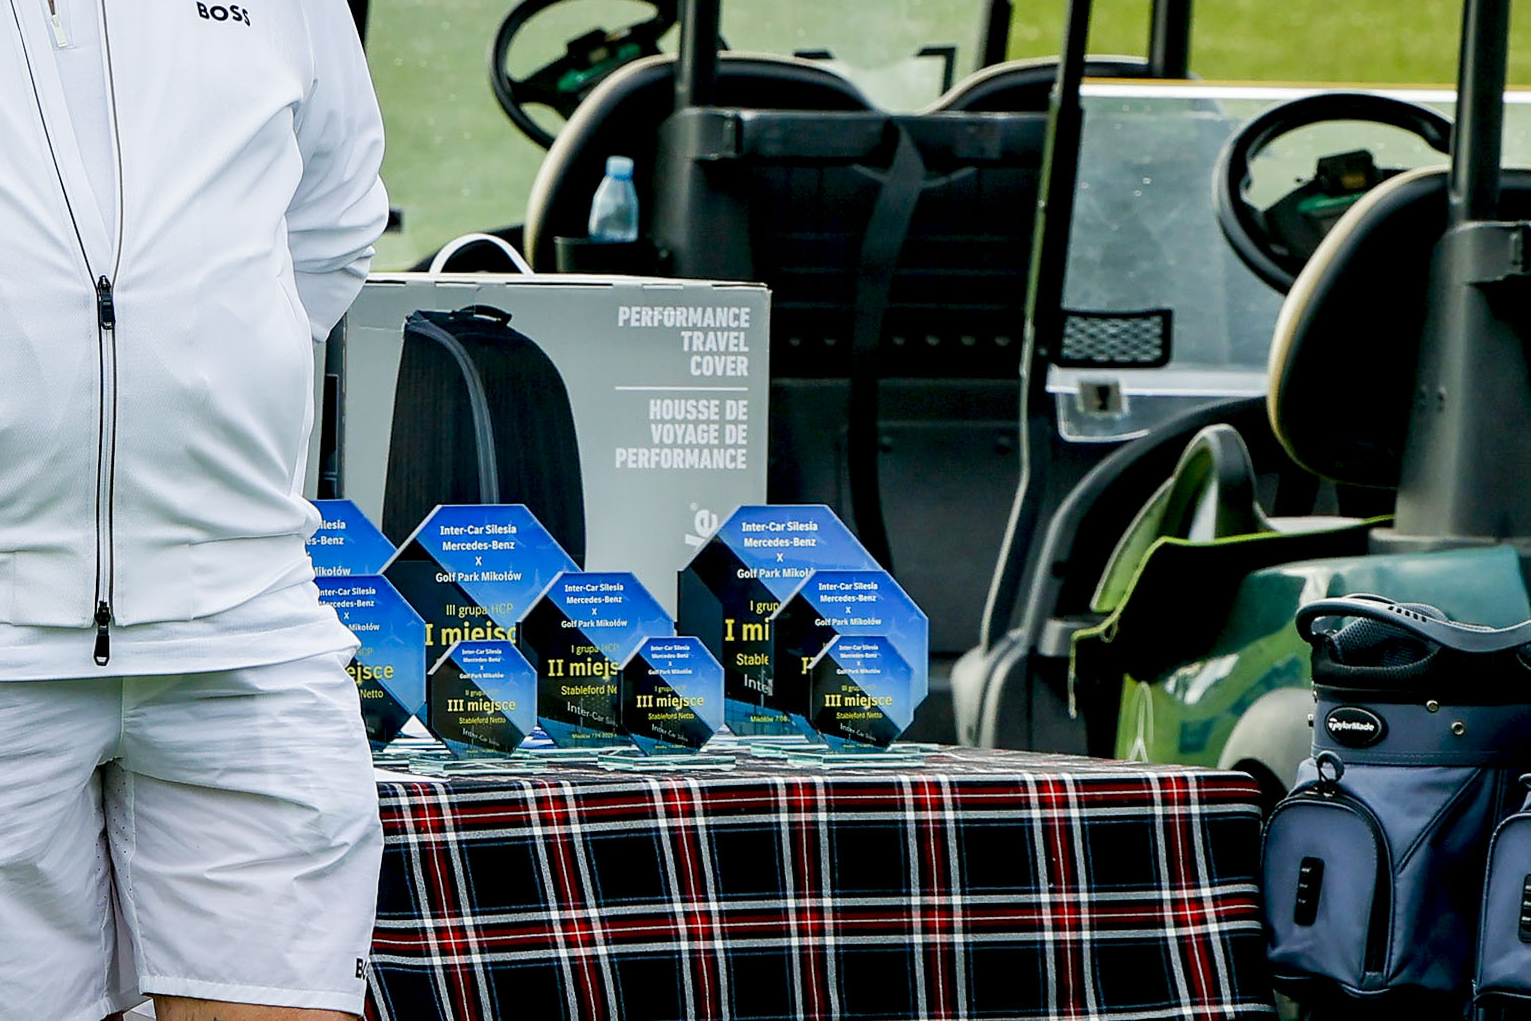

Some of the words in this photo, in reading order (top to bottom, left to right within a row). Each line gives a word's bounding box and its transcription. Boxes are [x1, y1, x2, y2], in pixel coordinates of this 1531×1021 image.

[196, 1, 250, 27] BOSS
[618, 306, 750, 327] PERFORMANCE
[681, 331, 749, 352] TRAVEL
[690, 355, 748, 376] COVER
[650, 399, 720, 420] HOUSSE
[725, 399, 748, 420] DE
[651, 424, 719, 445] VOYAGE
[725, 424, 748, 445] DE
[615, 448, 747, 469] PERFORMANCE
[440, 525, 484, 535] Inter-Car
[485, 524, 517, 534] Silesia
[741, 522, 786, 532] Inter-Car
[787, 521, 818, 532] Silesia
[306, 536, 345, 545] es-Benz
[442, 540, 516, 551] Mercedes-Benz
[743, 537, 817, 547] Mercedes-Benz
[435, 572, 456, 583] Golf
[458, 571, 479, 582] Park
[481, 570, 522, 581] Mikołów
[737, 568, 757, 579] Golf
[759, 568, 781, 578] Park
[351, 586, 376, 595] Silesia
[564, 584, 599, 592] Inter-Car
[599, 583, 624, 591] Silesia
[818, 583, 853, 591] Inter-Car
[853, 581, 878, 590] Silesia
[566, 595, 623, 604] Mercedes-Benz
[819, 594, 877, 602] Mercedes-Benz
[446, 604, 456, 616] III
[458, 605, 487, 619] grupa
[756, 602, 780, 614] grup
[561, 620, 577, 628] Golf
[578, 619, 595, 627] Park
[814, 618, 831, 627] Golf
[831, 617, 848, 626] Park
[724, 618, 735, 642] I
[576, 646, 599, 655] grupa
[736, 653, 769, 666] Stable
[346, 661, 394, 684] ejsce
[548, 658, 564, 677] II
[569, 657, 619, 680] miejs
[360, 688, 384, 699] Netto
[561, 684, 605, 696] Stableford
[447, 699, 465, 712] III
[467, 698, 516, 713] miejsce
[636, 695, 653, 708] III
[656, 694, 705, 710] miejsce
[824, 694, 842, 707] III
[844, 693, 893, 709] miejsce
